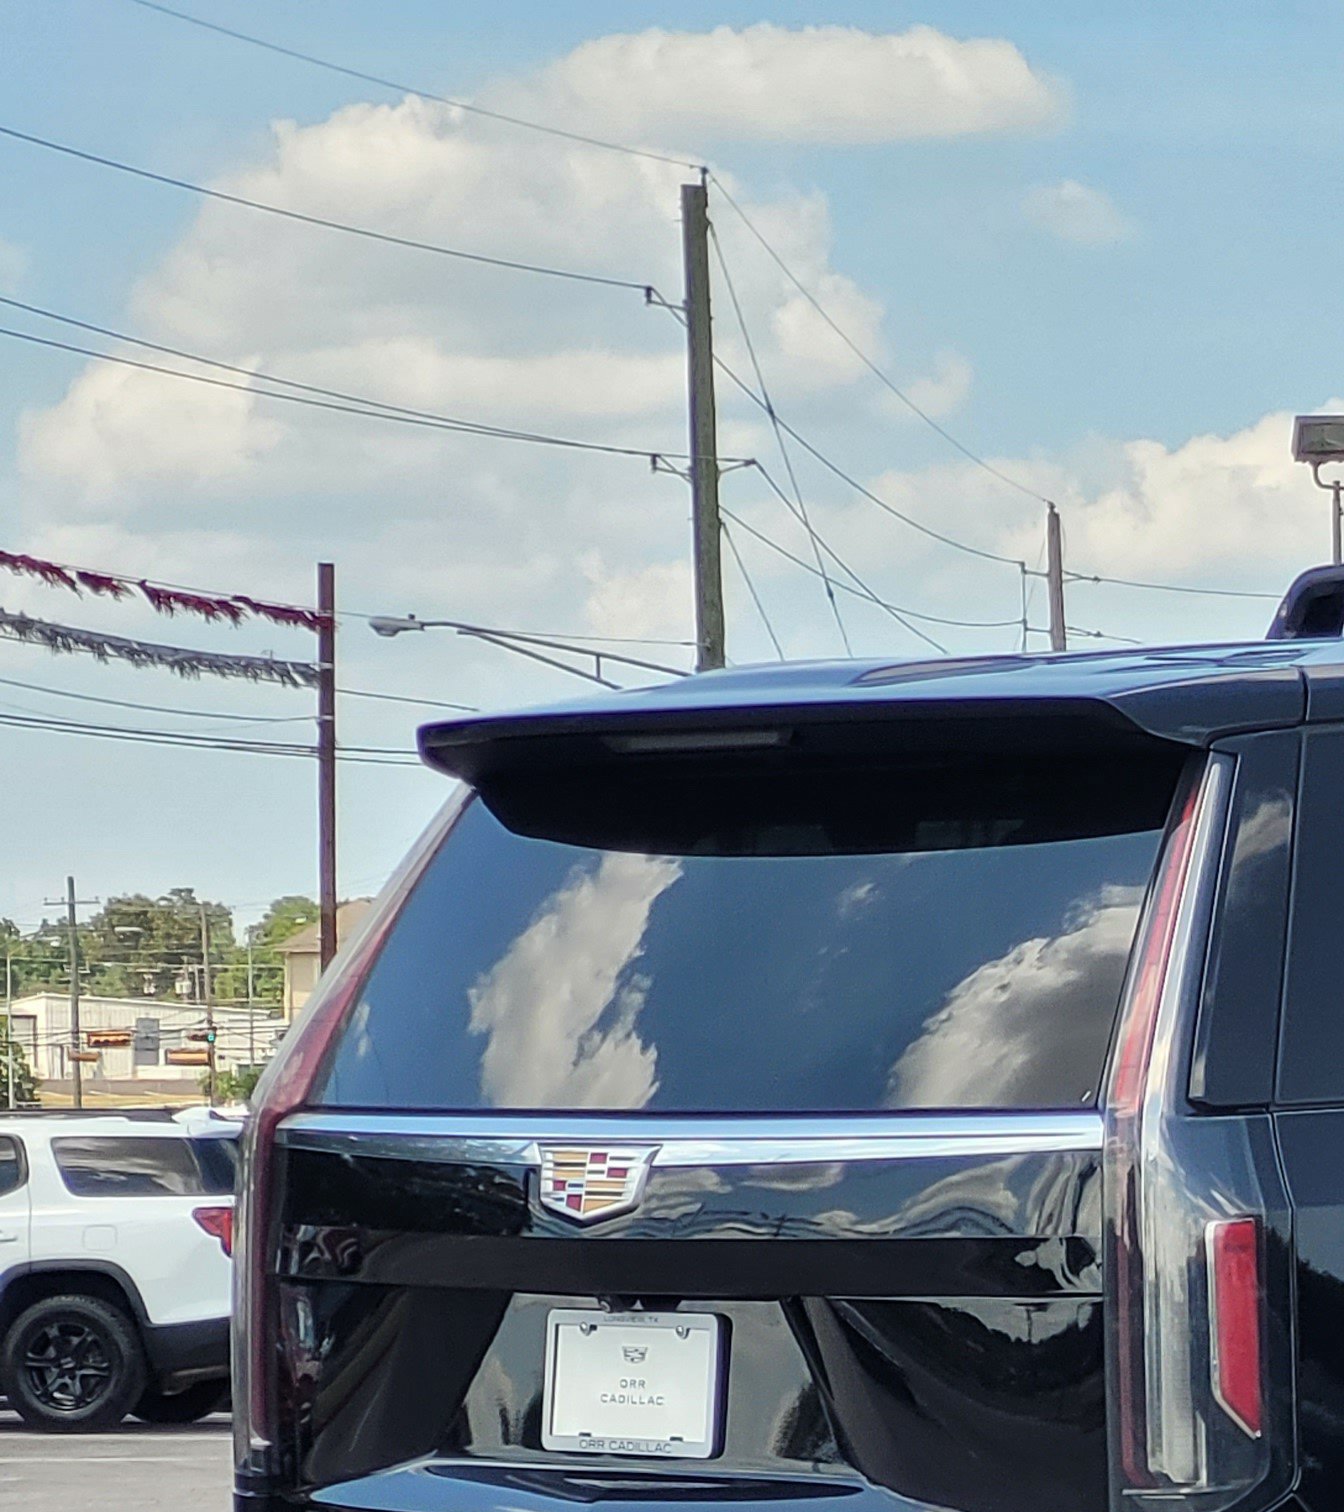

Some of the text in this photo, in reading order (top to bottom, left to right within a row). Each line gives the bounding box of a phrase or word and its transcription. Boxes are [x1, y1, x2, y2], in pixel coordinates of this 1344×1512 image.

[619, 1378, 647, 1389] ORR
[600, 1393, 665, 1406] CADILLAC
[579, 1438, 672, 1454] ORR CADILLAC
